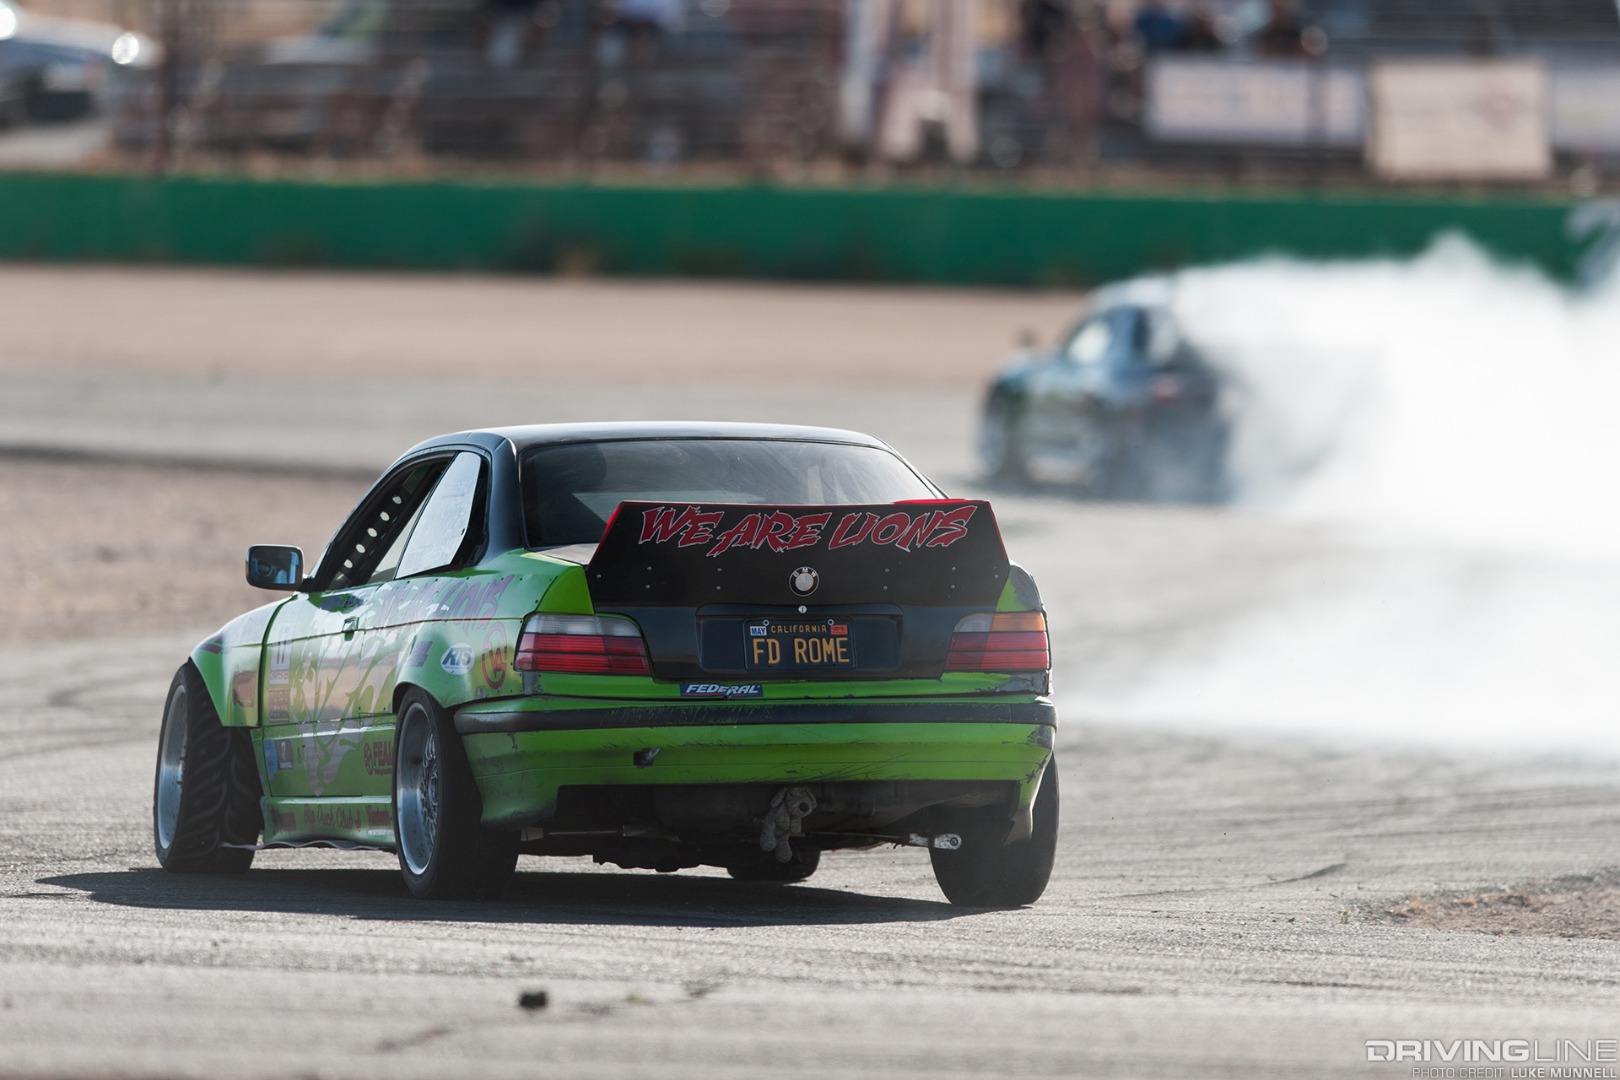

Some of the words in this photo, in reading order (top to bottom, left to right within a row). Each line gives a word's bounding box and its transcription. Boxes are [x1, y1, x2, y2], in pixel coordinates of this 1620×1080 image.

[639, 505, 724, 548] WE
[706, 510, 832, 557] ARE
[829, 505, 977, 552] LIONS
[751, 627, 767, 635] MAY
[770, 625, 827, 634] CALIFORNIA
[752, 638, 780, 664] FD
[794, 637, 850, 663] ROME
[686, 684, 760, 696] FEDERAL
